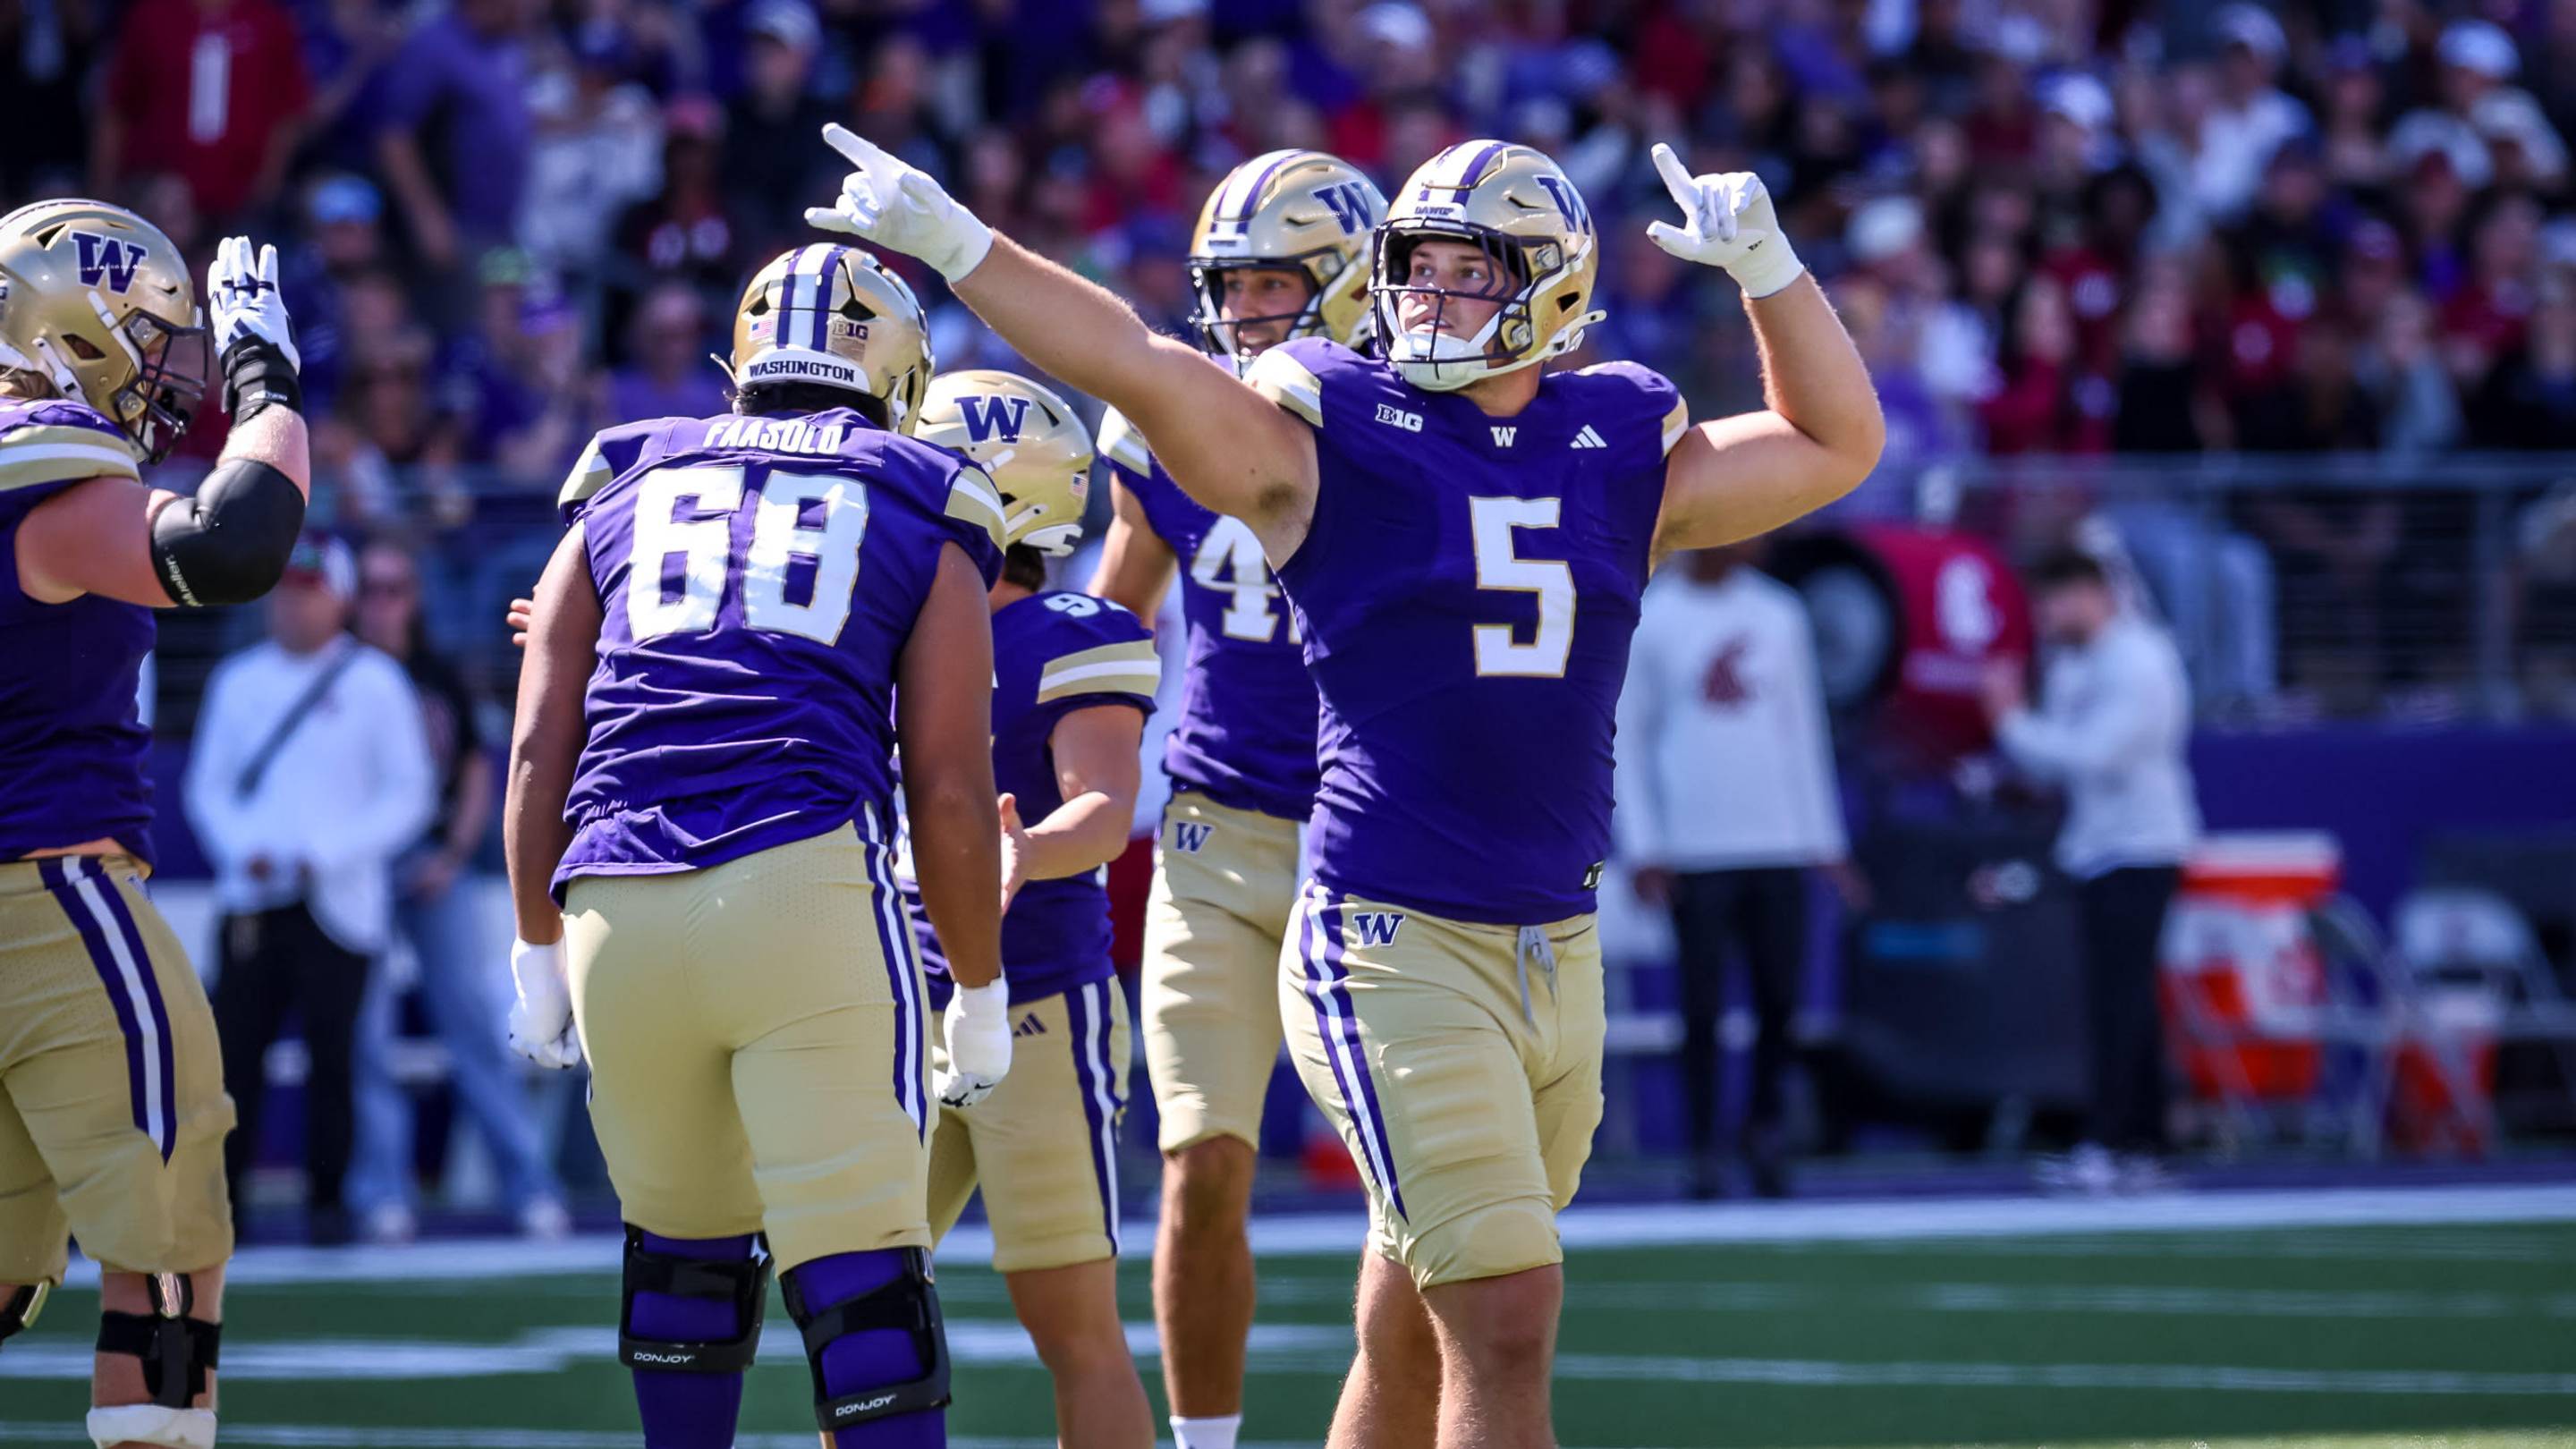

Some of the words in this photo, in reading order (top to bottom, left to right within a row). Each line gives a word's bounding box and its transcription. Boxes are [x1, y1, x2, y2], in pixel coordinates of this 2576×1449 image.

[1310, 181, 1373, 235] W
[1534, 175, 1590, 235] W
[70, 231, 148, 294] W
[749, 360, 855, 383] WASHINGTON
[702, 419, 844, 454] FAASOLO
[953, 394, 1031, 445] W
[1490, 427, 1517, 447] W
[627, 467, 870, 648] 68
[1191, 513, 1302, 644] 4
[1469, 496, 1577, 678] 5
[1175, 821, 1212, 852] W
[1353, 913, 1405, 948] W
[633, 1352, 691, 1363] DONJOY
[835, 1394, 896, 1417] DONJOY
